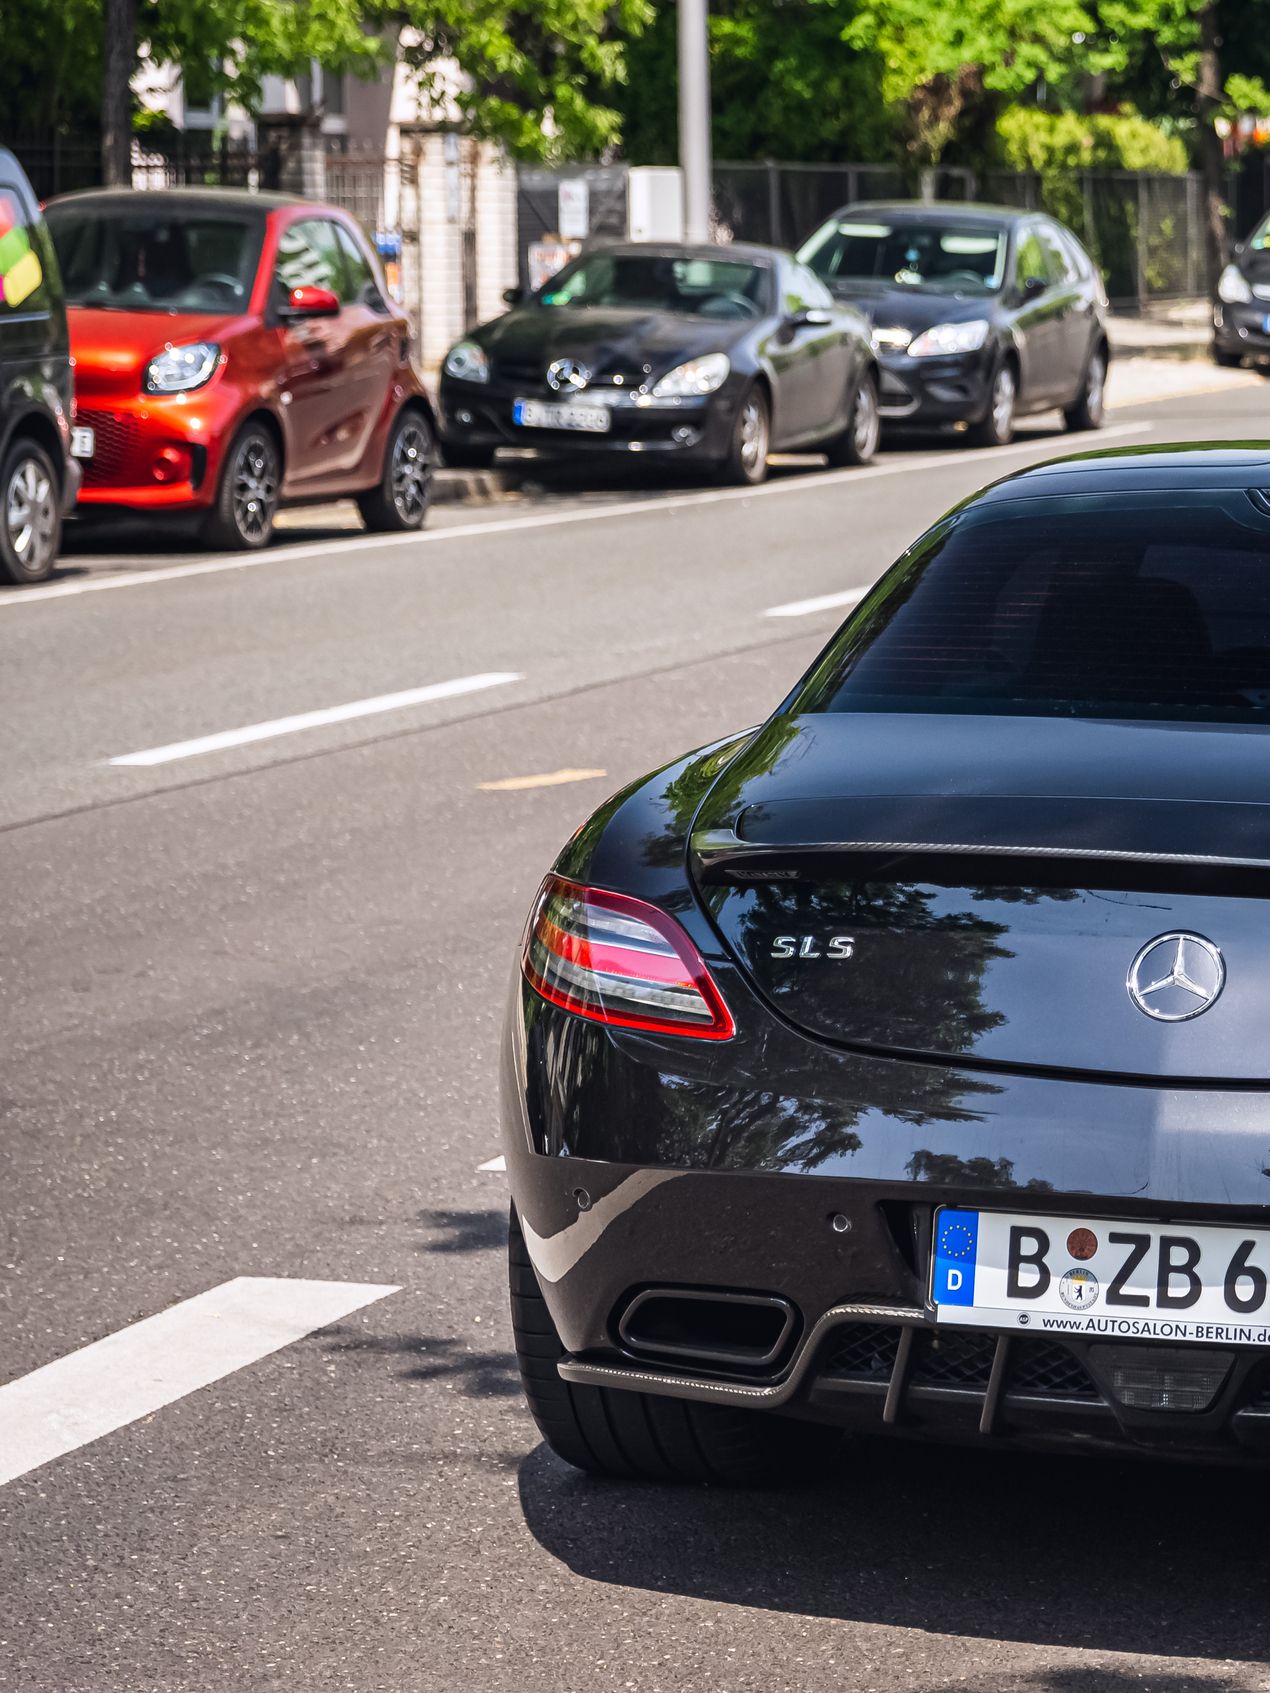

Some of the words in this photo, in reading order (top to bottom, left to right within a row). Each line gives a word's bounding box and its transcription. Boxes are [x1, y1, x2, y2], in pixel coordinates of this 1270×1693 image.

[770, 936, 855, 959] SLS
[1007, 1226, 1051, 1299] B
[1105, 1231, 1203, 1309] ZB
[947, 1269, 963, 1291] D
